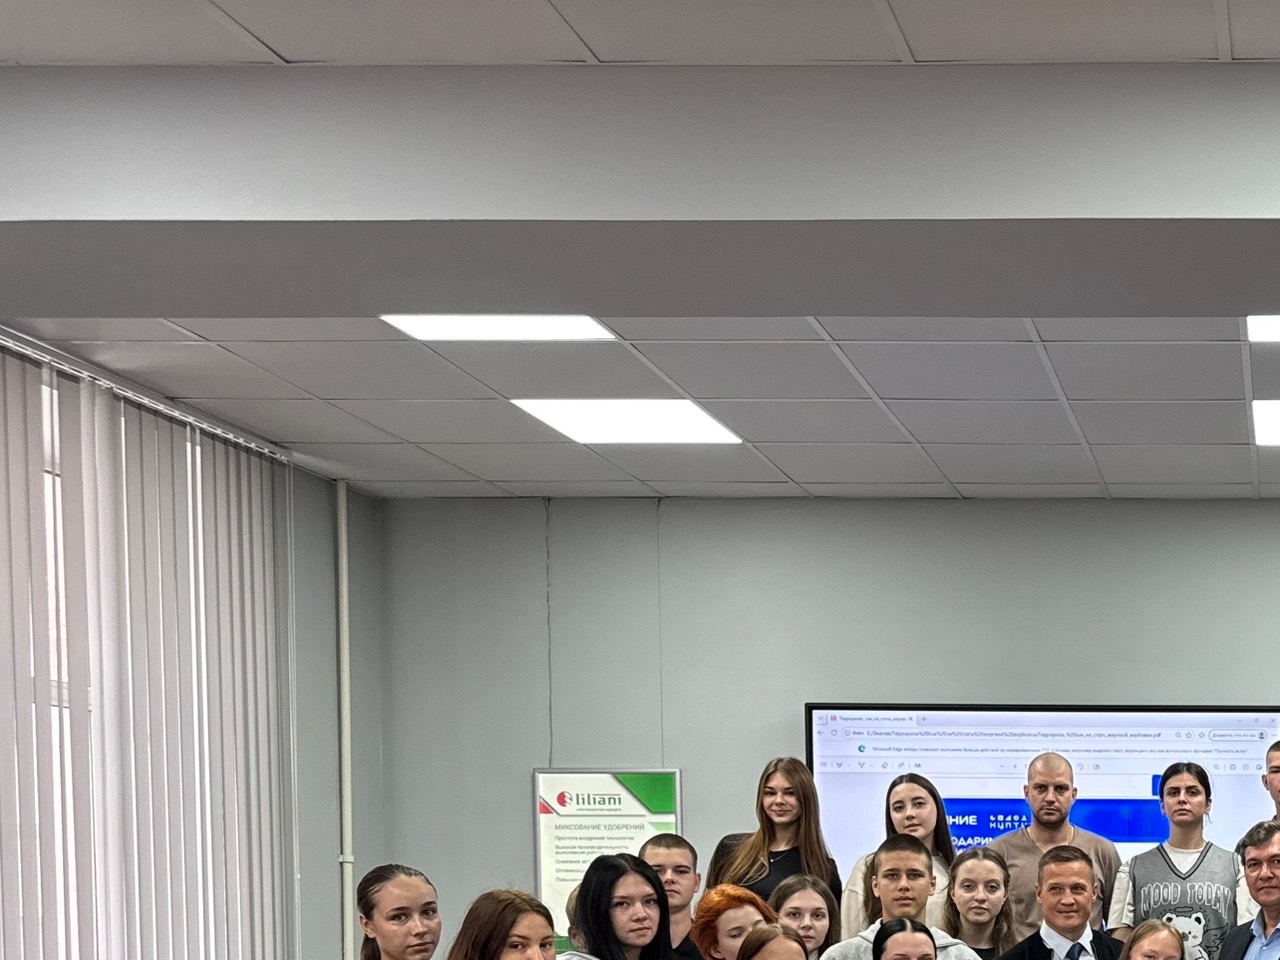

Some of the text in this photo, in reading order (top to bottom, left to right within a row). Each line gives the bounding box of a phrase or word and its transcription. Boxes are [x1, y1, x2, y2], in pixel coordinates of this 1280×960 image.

[576, 793, 622, 806] liliani
[946, 815, 978, 826] НИЕ
[603, 823, 645, 831] УДОБРЕНИЙ
[1141, 881, 1231, 920] MOOD TODAY
